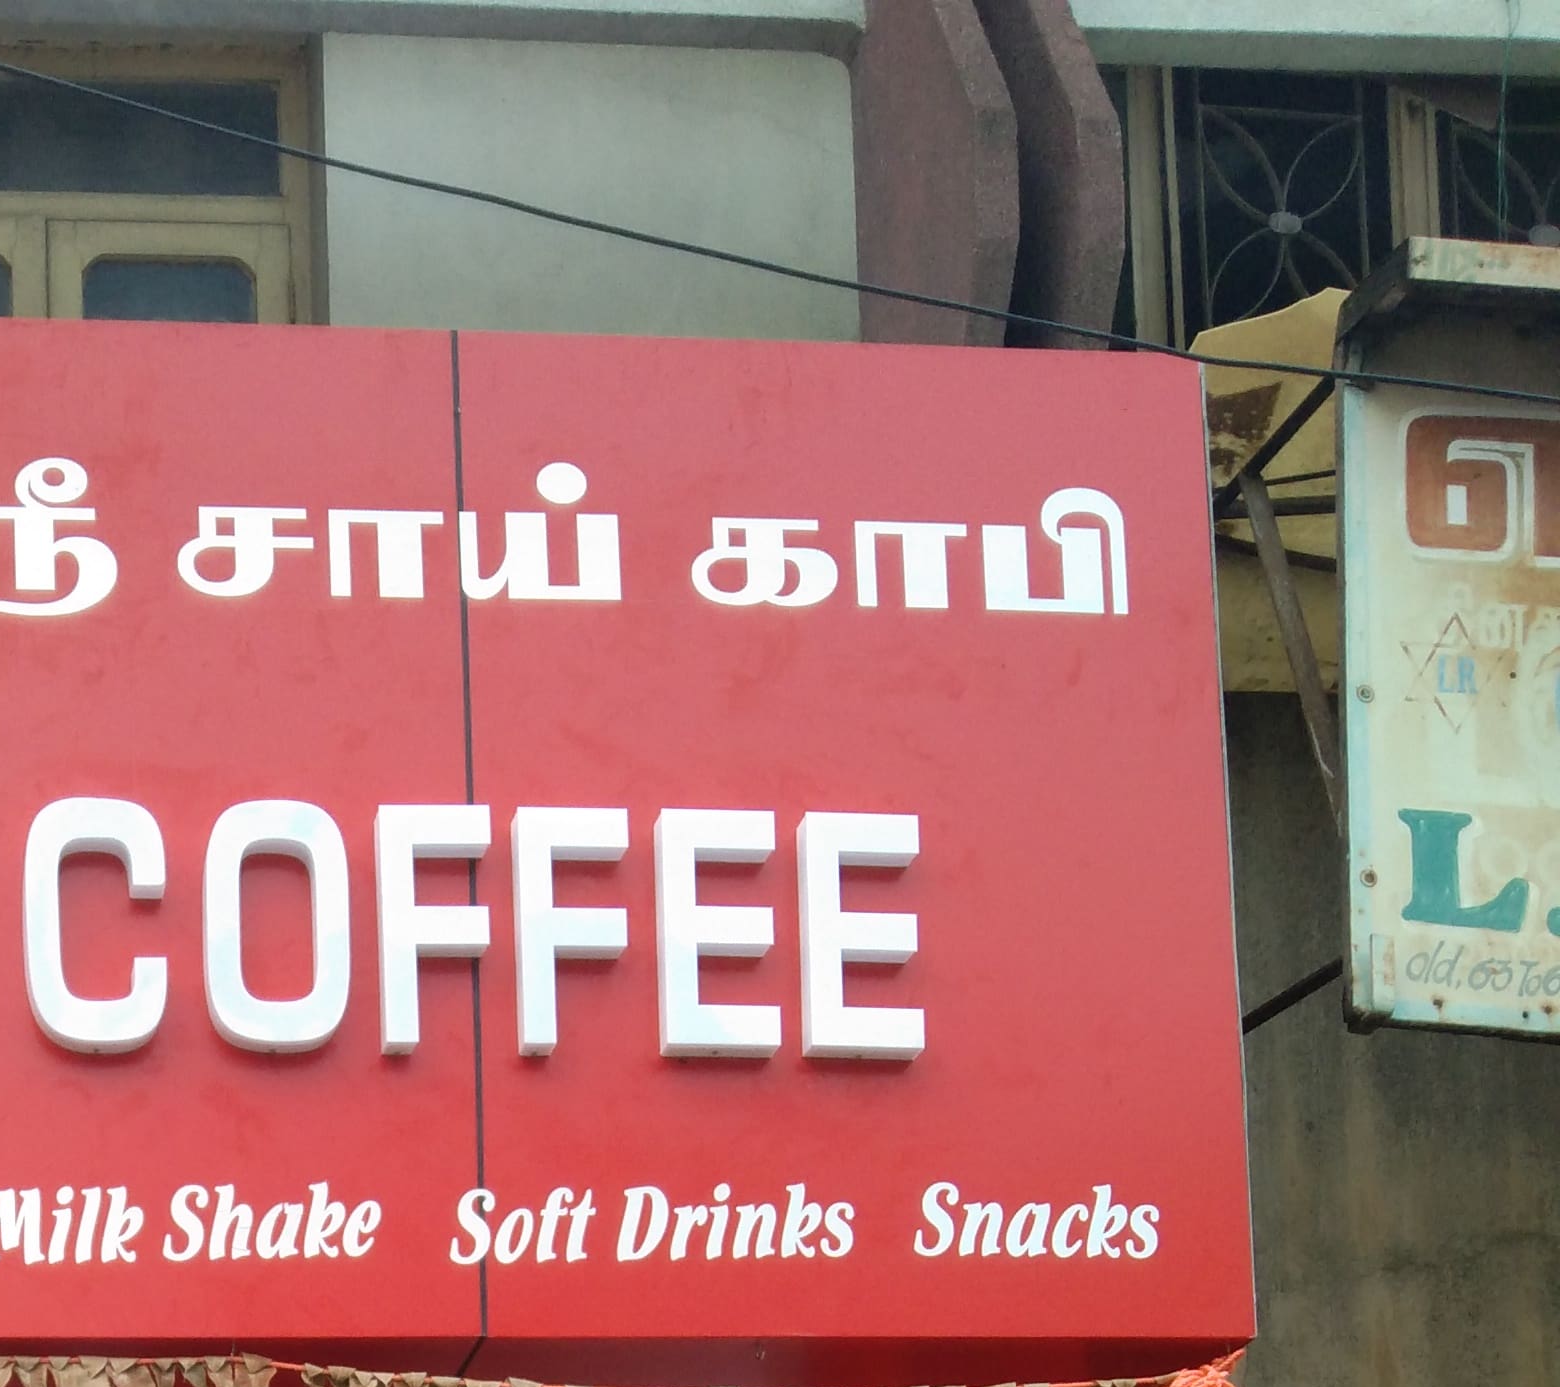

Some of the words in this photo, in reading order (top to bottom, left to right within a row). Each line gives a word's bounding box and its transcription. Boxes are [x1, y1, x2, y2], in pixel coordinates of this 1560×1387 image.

[176, 461, 622, 602] சாய்
[690, 486, 1130, 616] காபி
[22, 797, 926, 1062] COFFEE
[162, 1181, 382, 1263] Shake
[448, 1185, 597, 1266] Soft
[615, 1182, 856, 1263] Drinks
[913, 1180, 1161, 1260] Snacks
